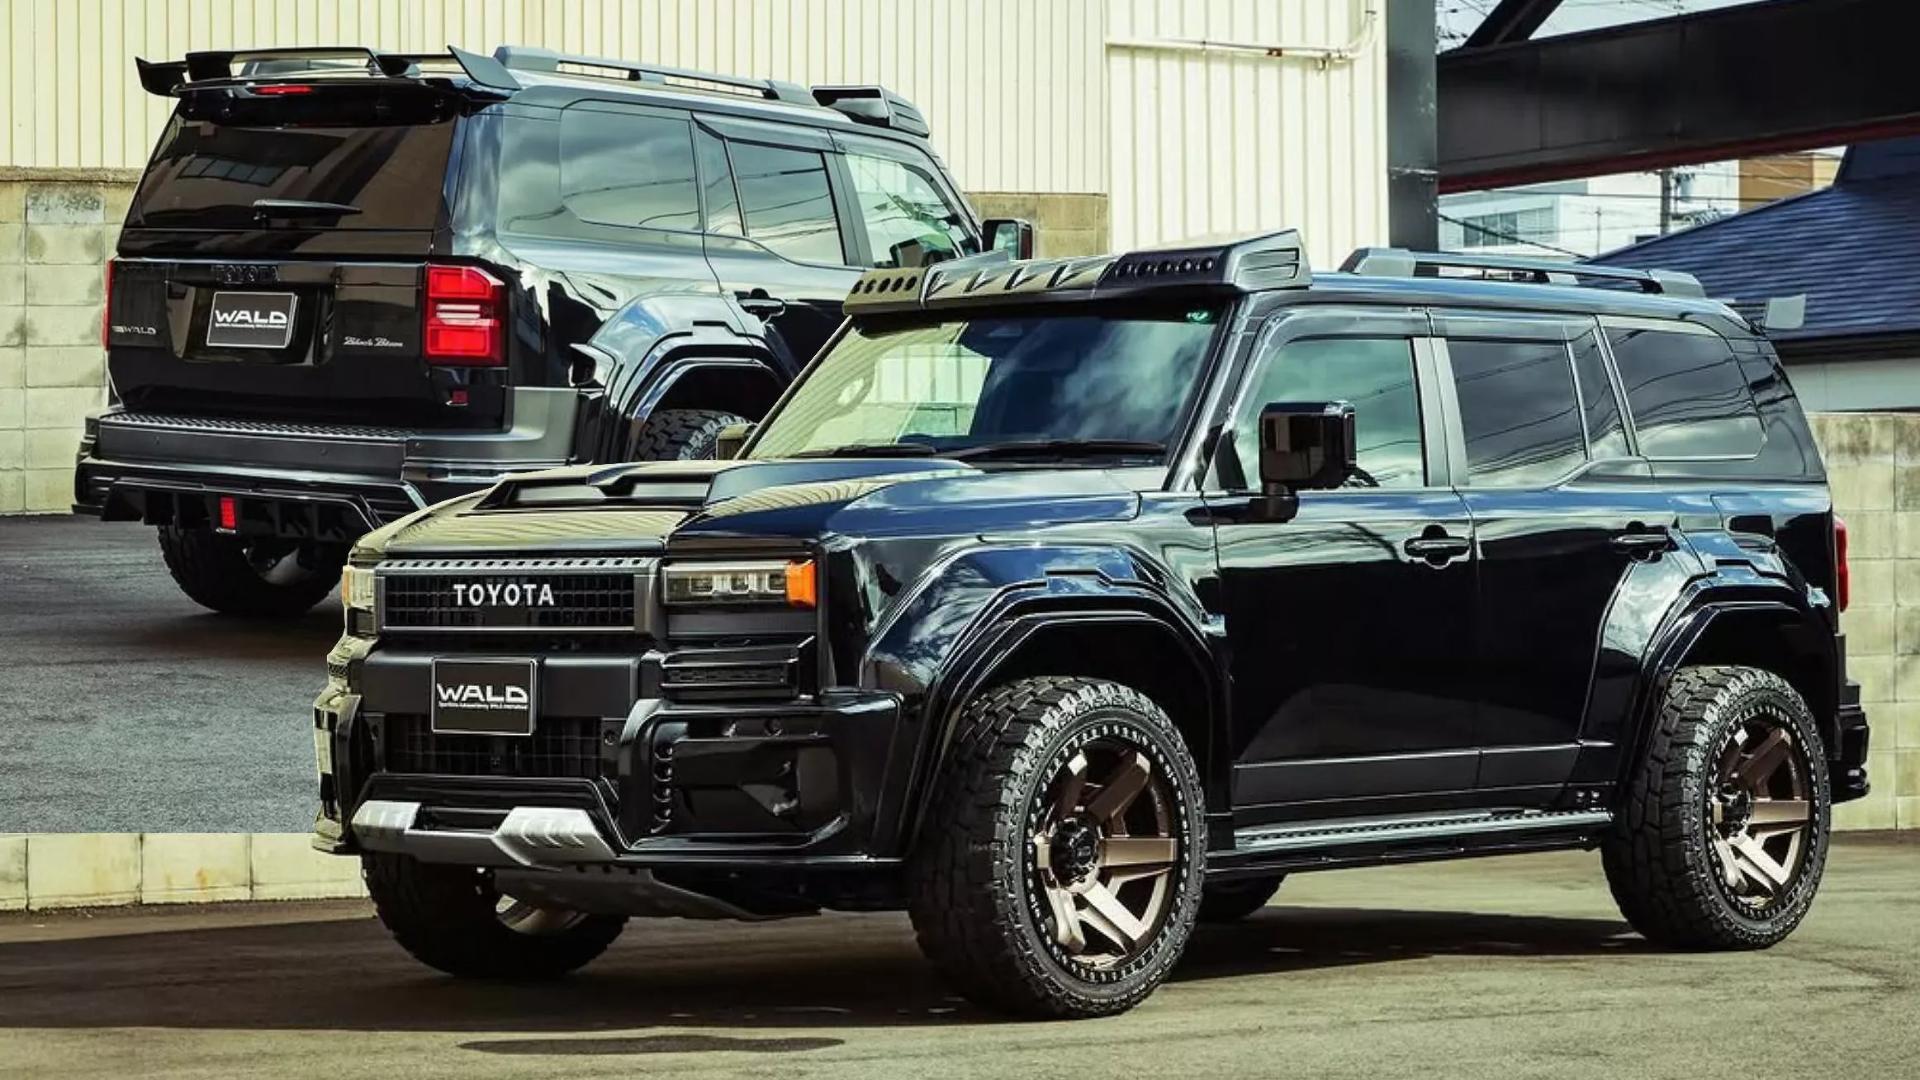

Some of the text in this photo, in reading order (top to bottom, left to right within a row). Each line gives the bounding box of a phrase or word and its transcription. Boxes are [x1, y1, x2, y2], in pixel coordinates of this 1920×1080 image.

[215, 309, 288, 324] WALD
[453, 583, 555, 606] TOYOTA
[436, 682, 529, 703] WALD
